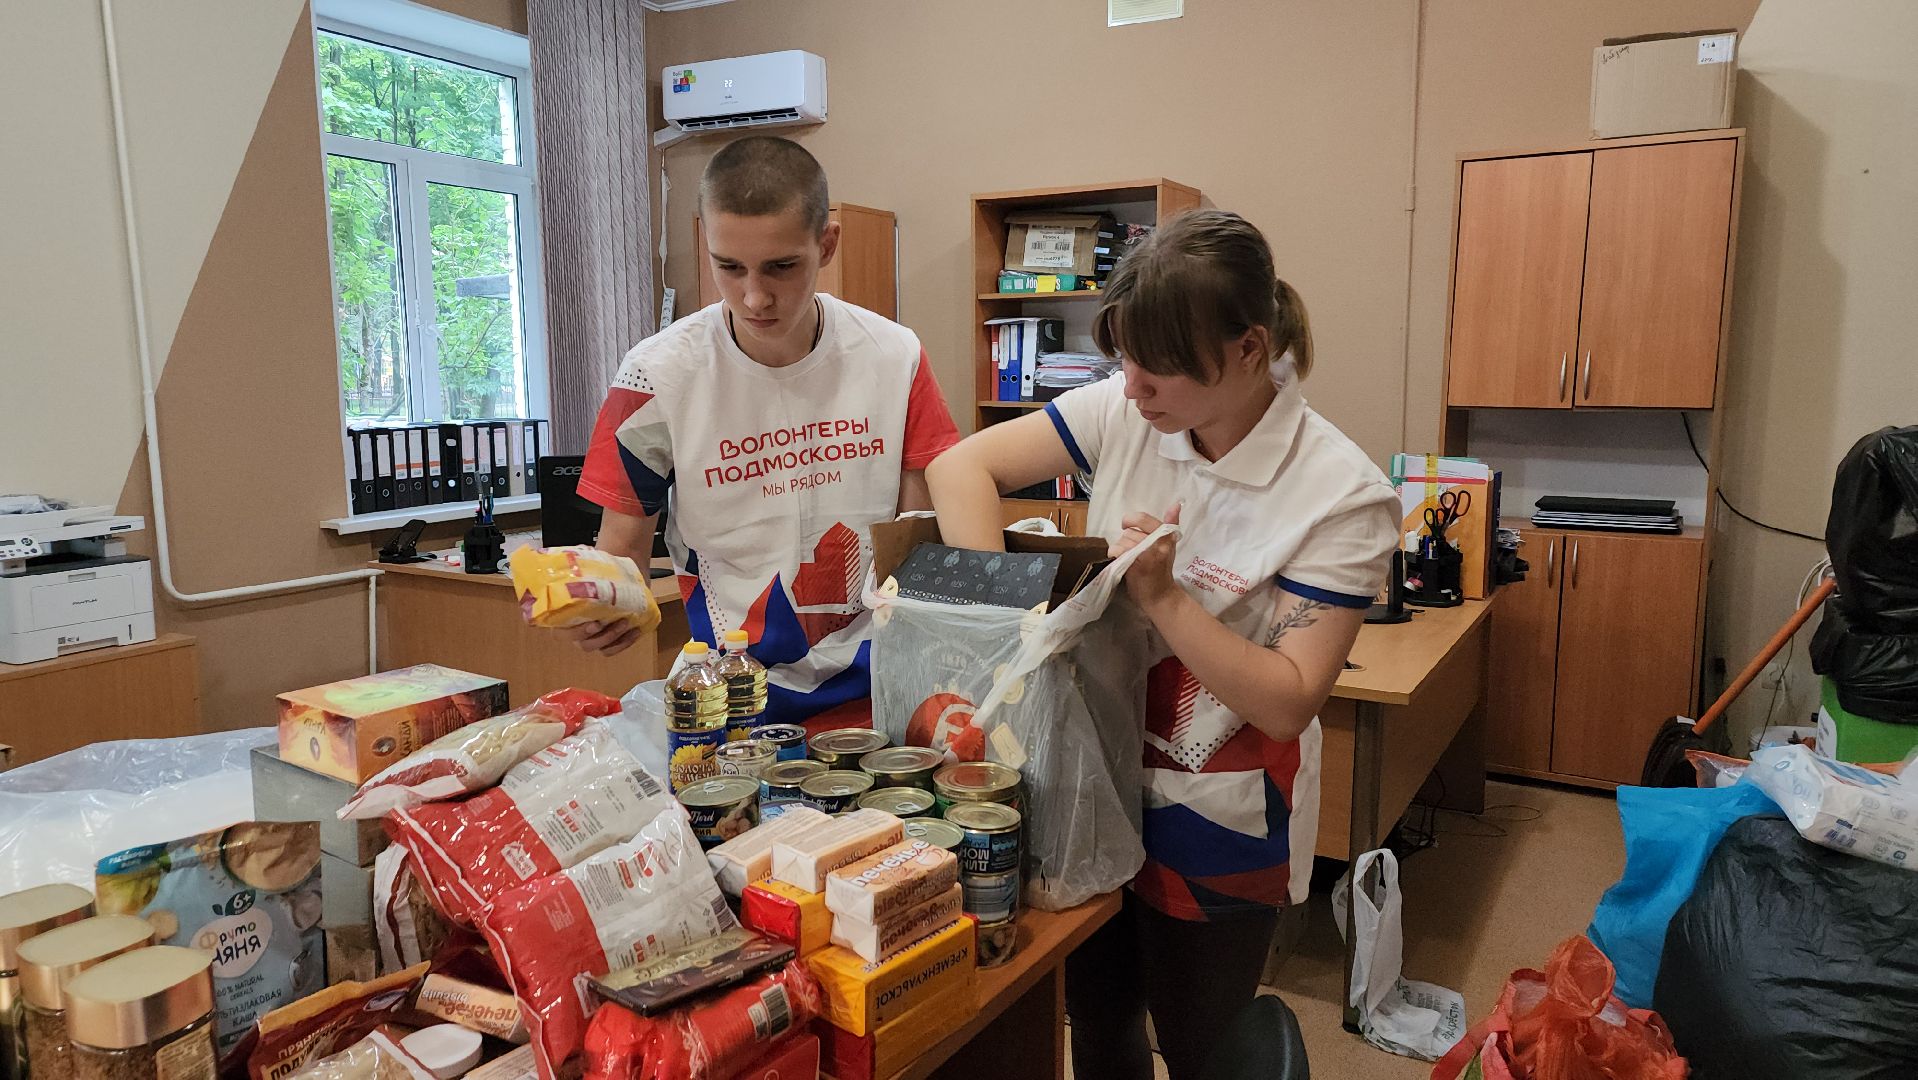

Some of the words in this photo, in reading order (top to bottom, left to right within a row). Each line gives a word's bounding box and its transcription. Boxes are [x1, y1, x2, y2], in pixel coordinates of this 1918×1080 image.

[719, 416, 869, 461] ВОЛОНТЕРЫ
[552, 465, 579, 475] ace
[704, 438, 885, 488] ПОДМОСКОВЬЯ
[763, 480, 786, 498] МЫ
[790, 470, 842, 492] РЯДОМ
[1192, 555, 1249, 586] ВОЛОНТЕРЫ
[1190, 579, 1215, 593] РЯДОМ
[850, 839, 931, 888] печенье
[232, 894, 252, 909] 6+
[199, 921, 257, 949] Фруто
[232, 1011, 258, 1028] КАША
